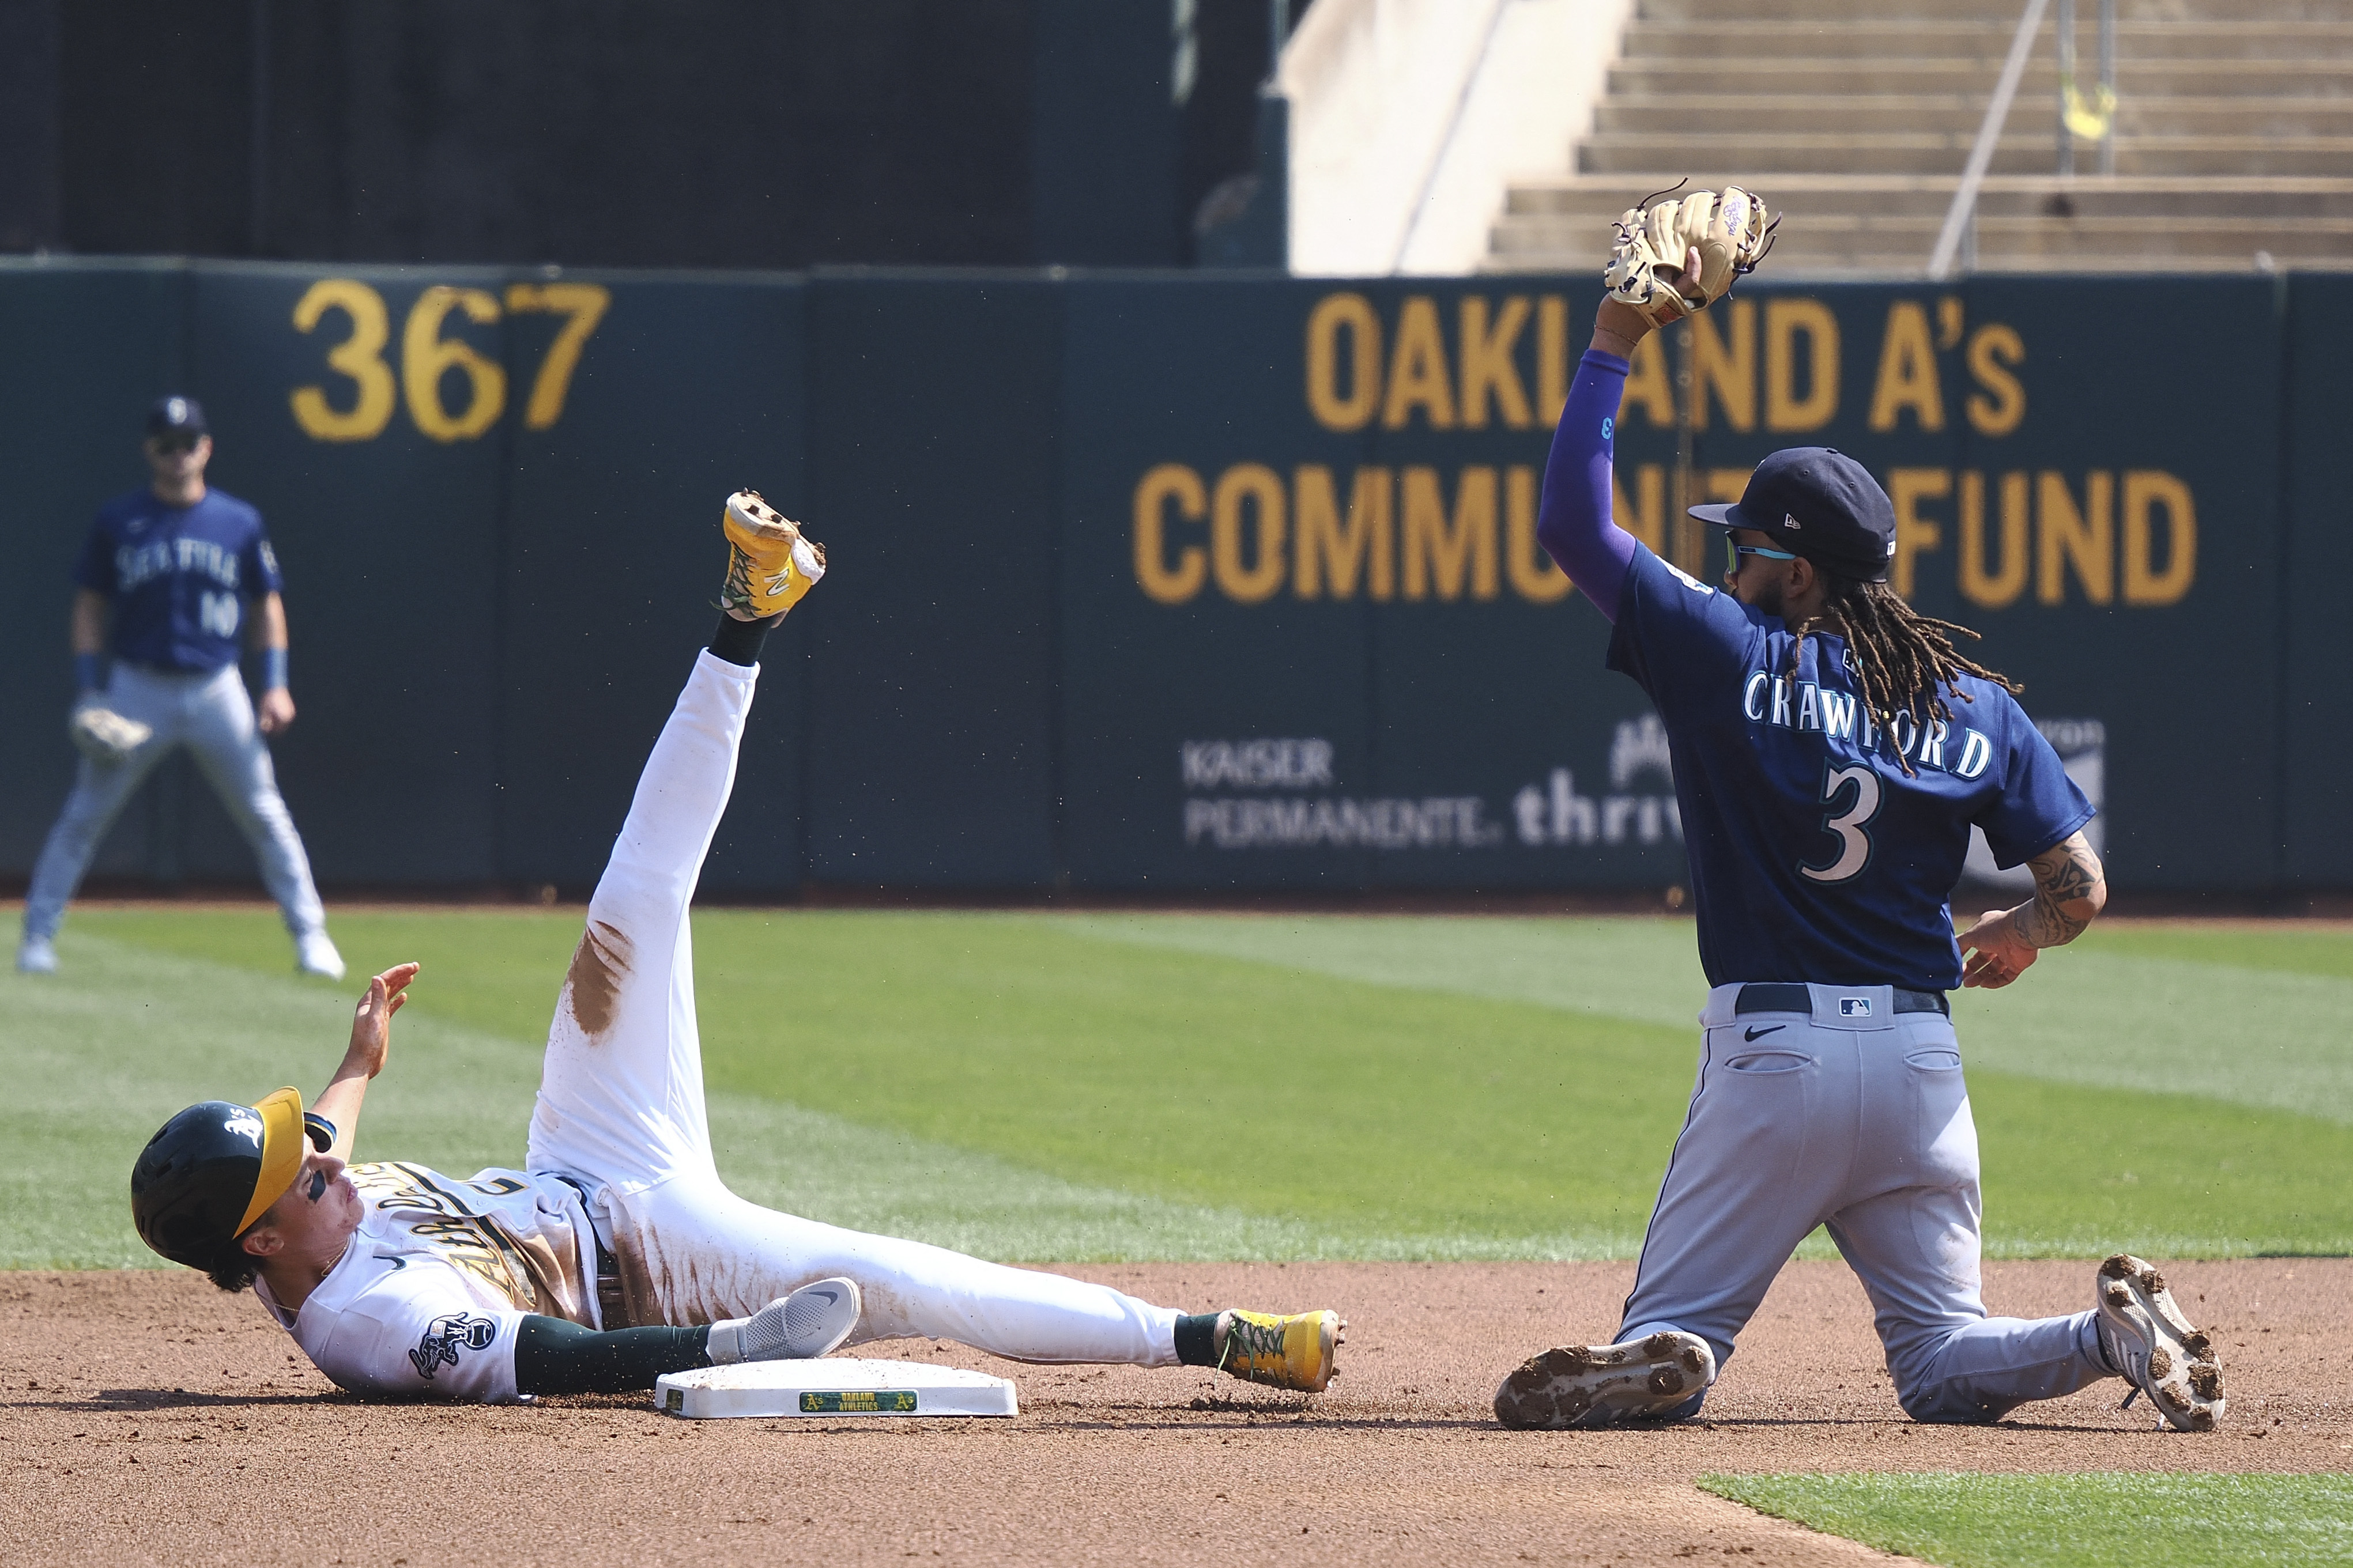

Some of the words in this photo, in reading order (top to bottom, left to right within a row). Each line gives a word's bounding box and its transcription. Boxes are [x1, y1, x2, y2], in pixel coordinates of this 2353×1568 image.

[291, 278, 611, 443] 367
[1304, 292, 1841, 434] OAKLAND
[1887, 467, 2197, 609] FUND
[1181, 738, 1334, 788] KAISER
[1743, 670, 1992, 780] CRAWFORD
[1795, 755, 1885, 886] 3
[839, 1401, 878, 1411] ATHLETICS
[842, 1392, 875, 1401] OAKLAND
